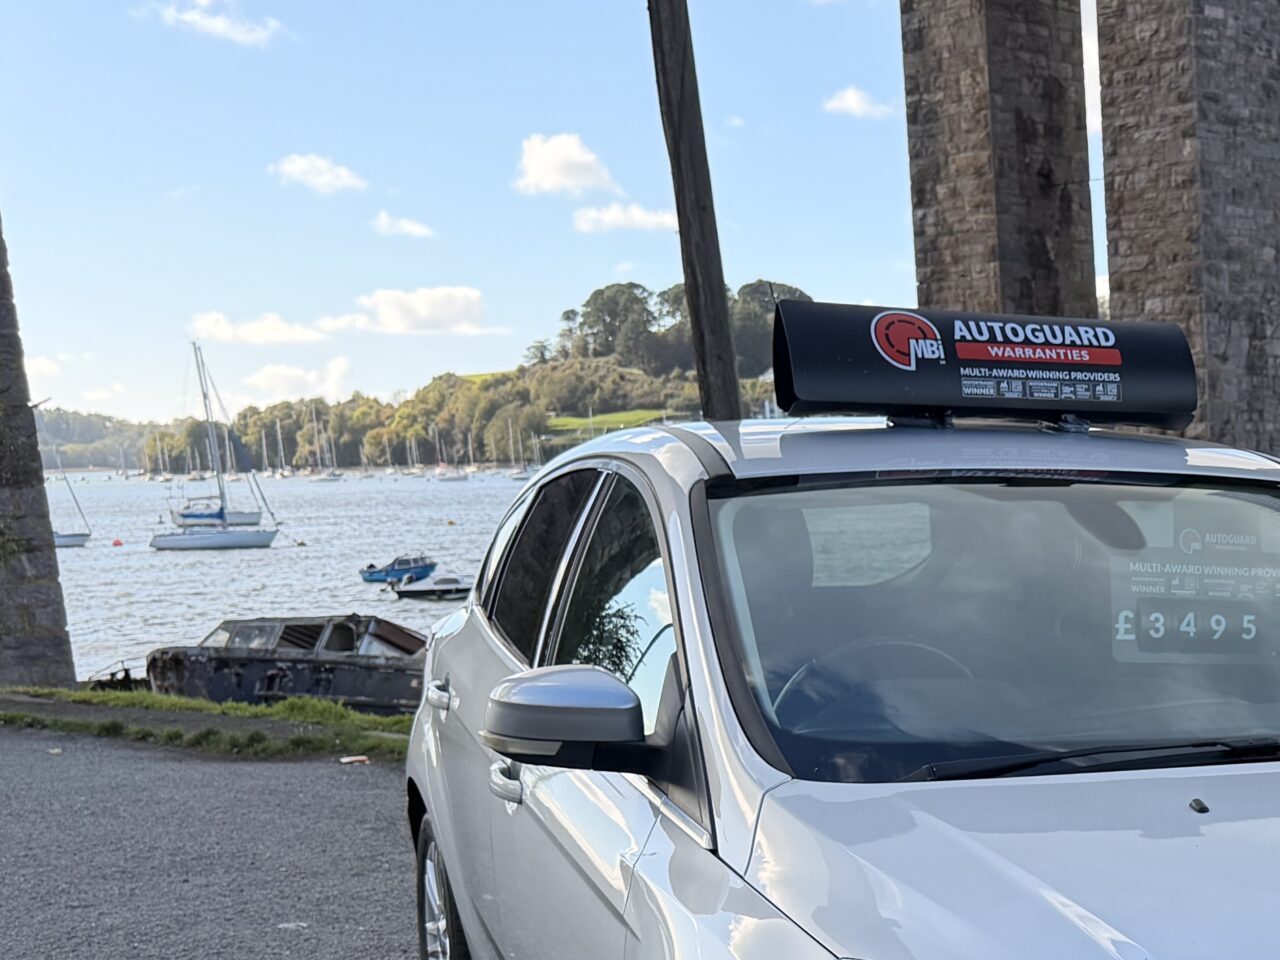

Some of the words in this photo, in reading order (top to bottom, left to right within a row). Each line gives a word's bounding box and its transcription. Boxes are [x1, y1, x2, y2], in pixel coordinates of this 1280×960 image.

[954, 320, 1116, 346] AUTOGUARD
[988, 346, 1089, 361] WARRANTIES
[960, 367, 1026, 378] MULTI-AWARD
[1027, 371, 1069, 380] WINNING
[1070, 373, 1121, 382] PROVIDERS
[963, 387, 994, 396] WINNER
[1204, 533, 1257, 545] AUTOGUARD
[1129, 562, 1202, 575] MULTI-AWARD
[1204, 566, 1249, 577] WINNING
[1131, 584, 1165, 594] WINNER
